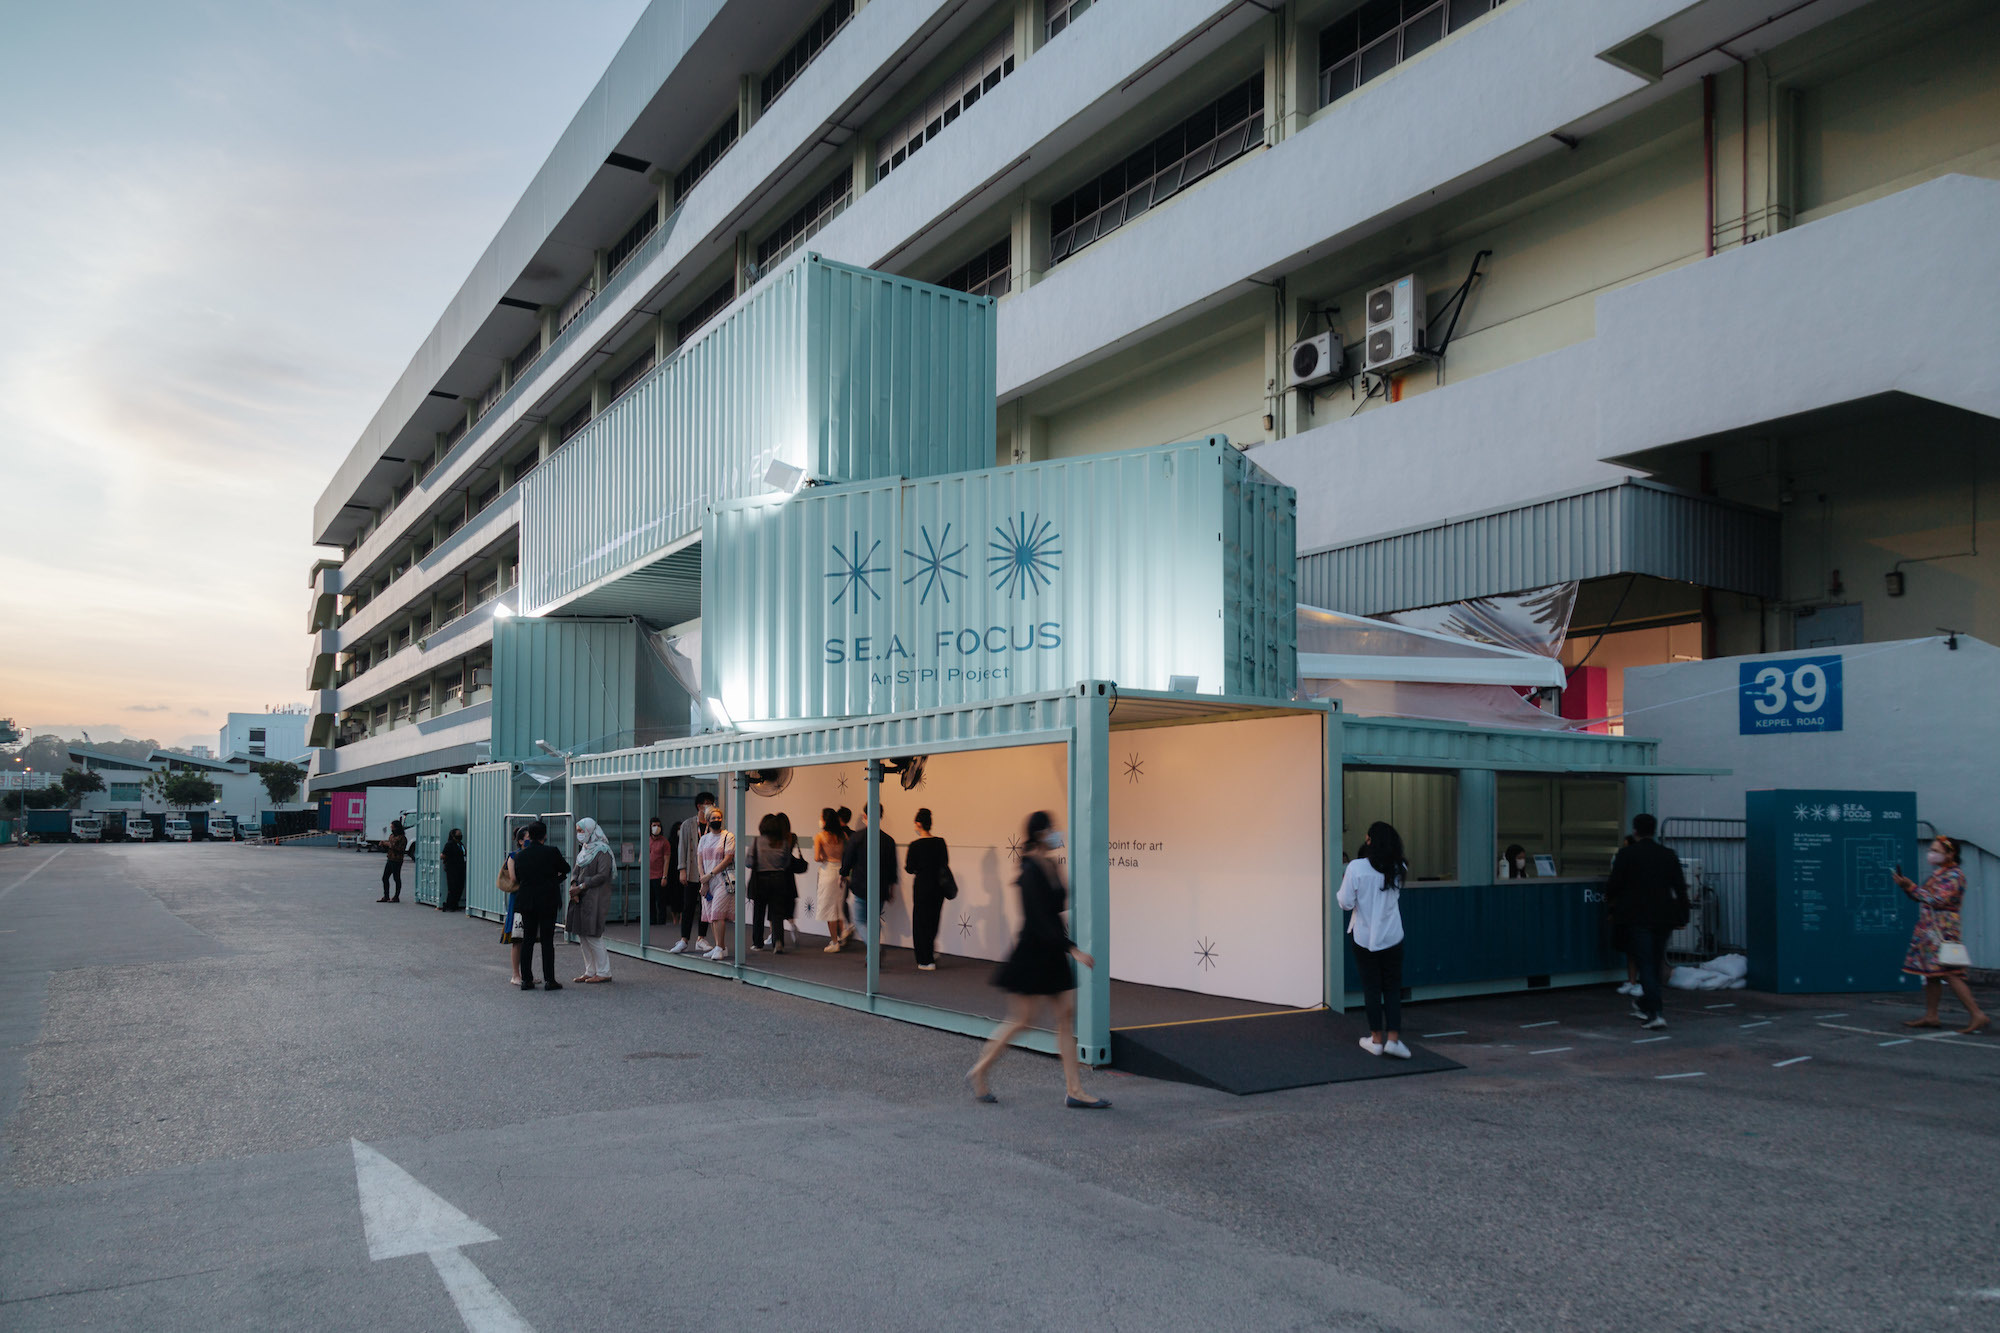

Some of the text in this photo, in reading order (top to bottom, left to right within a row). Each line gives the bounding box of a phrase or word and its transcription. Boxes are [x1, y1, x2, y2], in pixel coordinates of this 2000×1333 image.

[825, 622, 1062, 664] S.E.A. FOCUS
[871, 671, 893, 685] An
[948, 666, 1010, 683] Project
[1754, 663, 1827, 716] 39
[1755, 716, 1825, 728] KEPPEL ROAD
[1843, 810, 1872, 818] FOCUS
[1133, 839, 1147, 850] for
[1149, 841, 1163, 851] art
[1058, 854, 1067, 865] in
[1117, 856, 1139, 867] Asia
